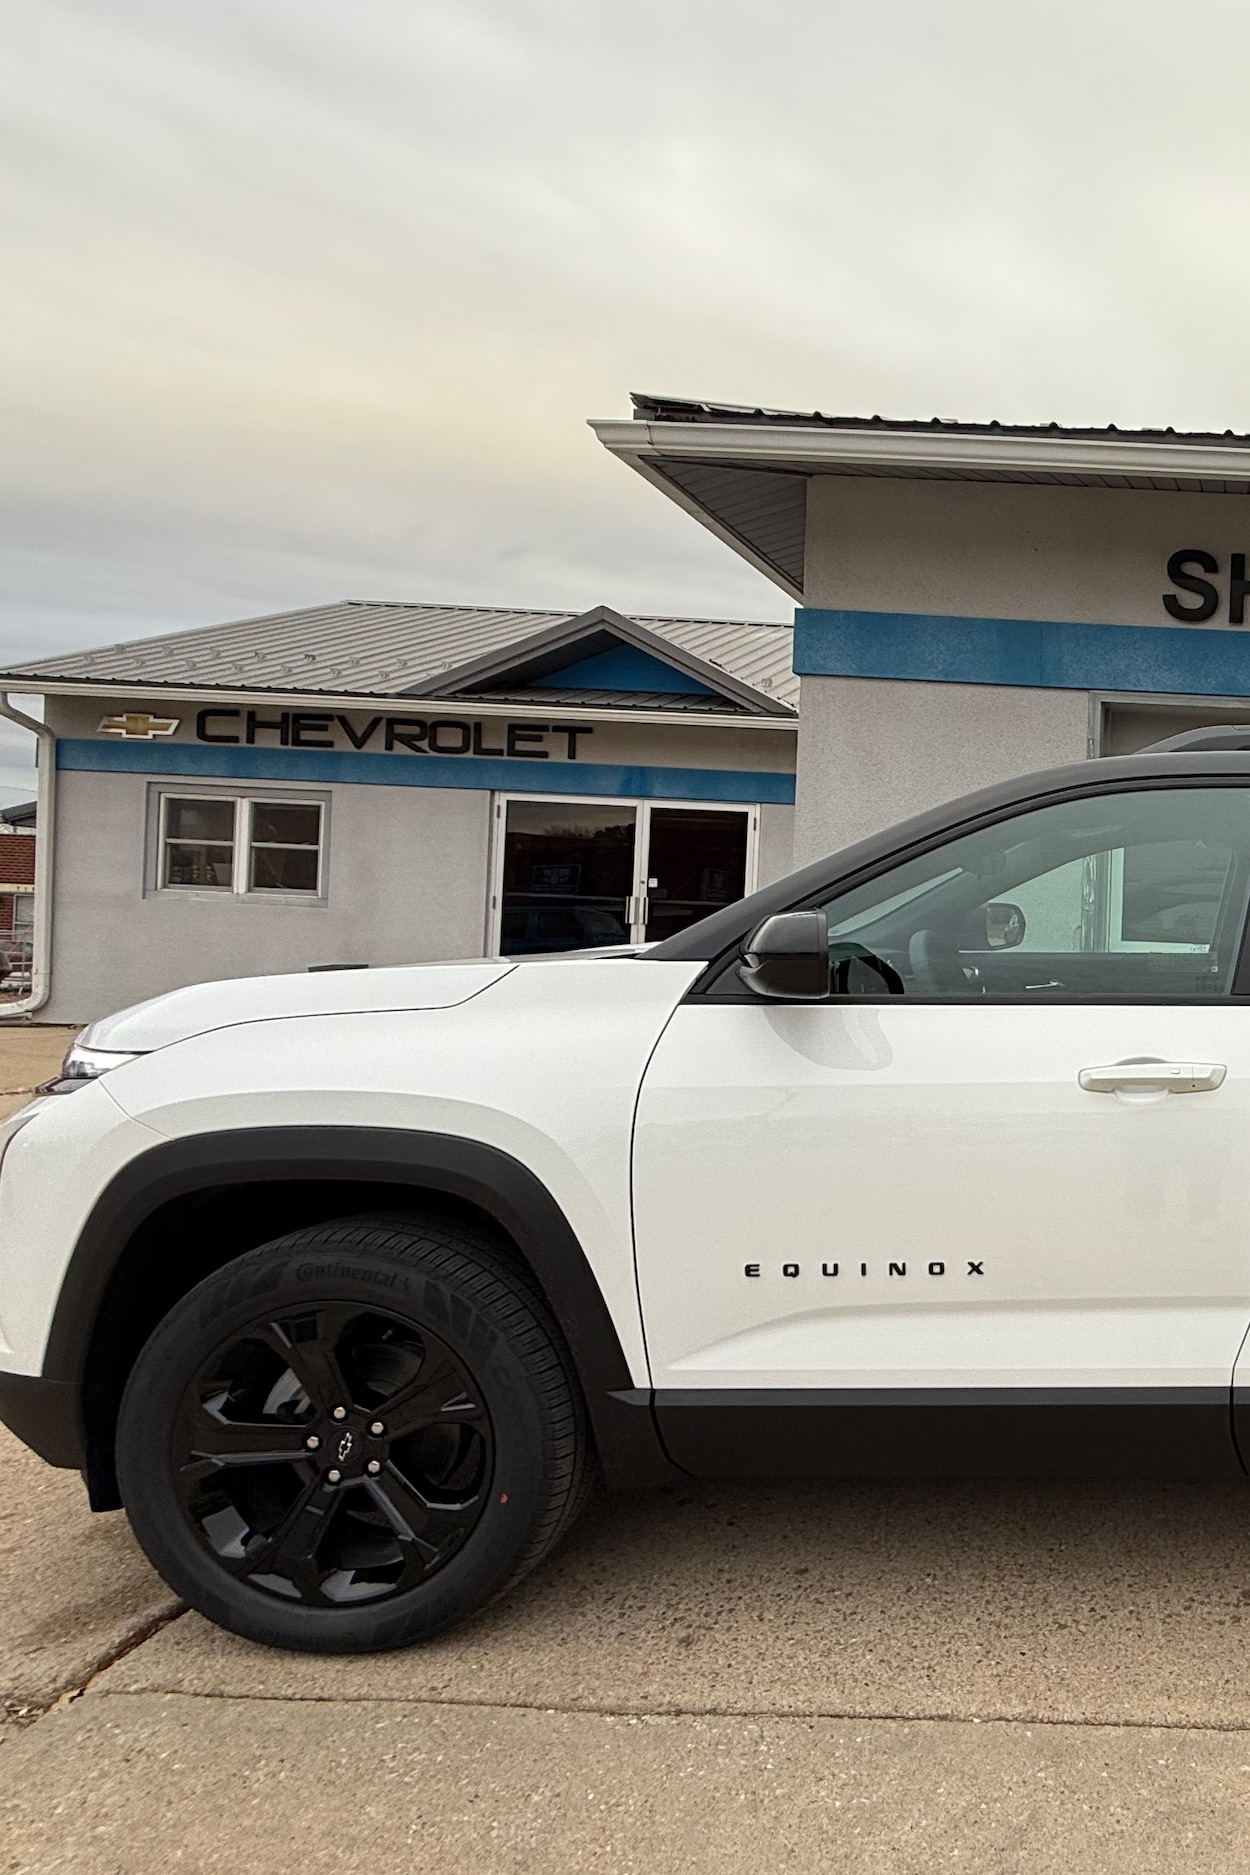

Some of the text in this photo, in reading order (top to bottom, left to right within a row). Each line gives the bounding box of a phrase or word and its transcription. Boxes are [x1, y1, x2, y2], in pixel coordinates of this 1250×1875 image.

[196, 709, 593, 760] CHEVROLET
[295, 1261, 399, 1288] Continental
[744, 1262, 985, 1278] EQUINOX
